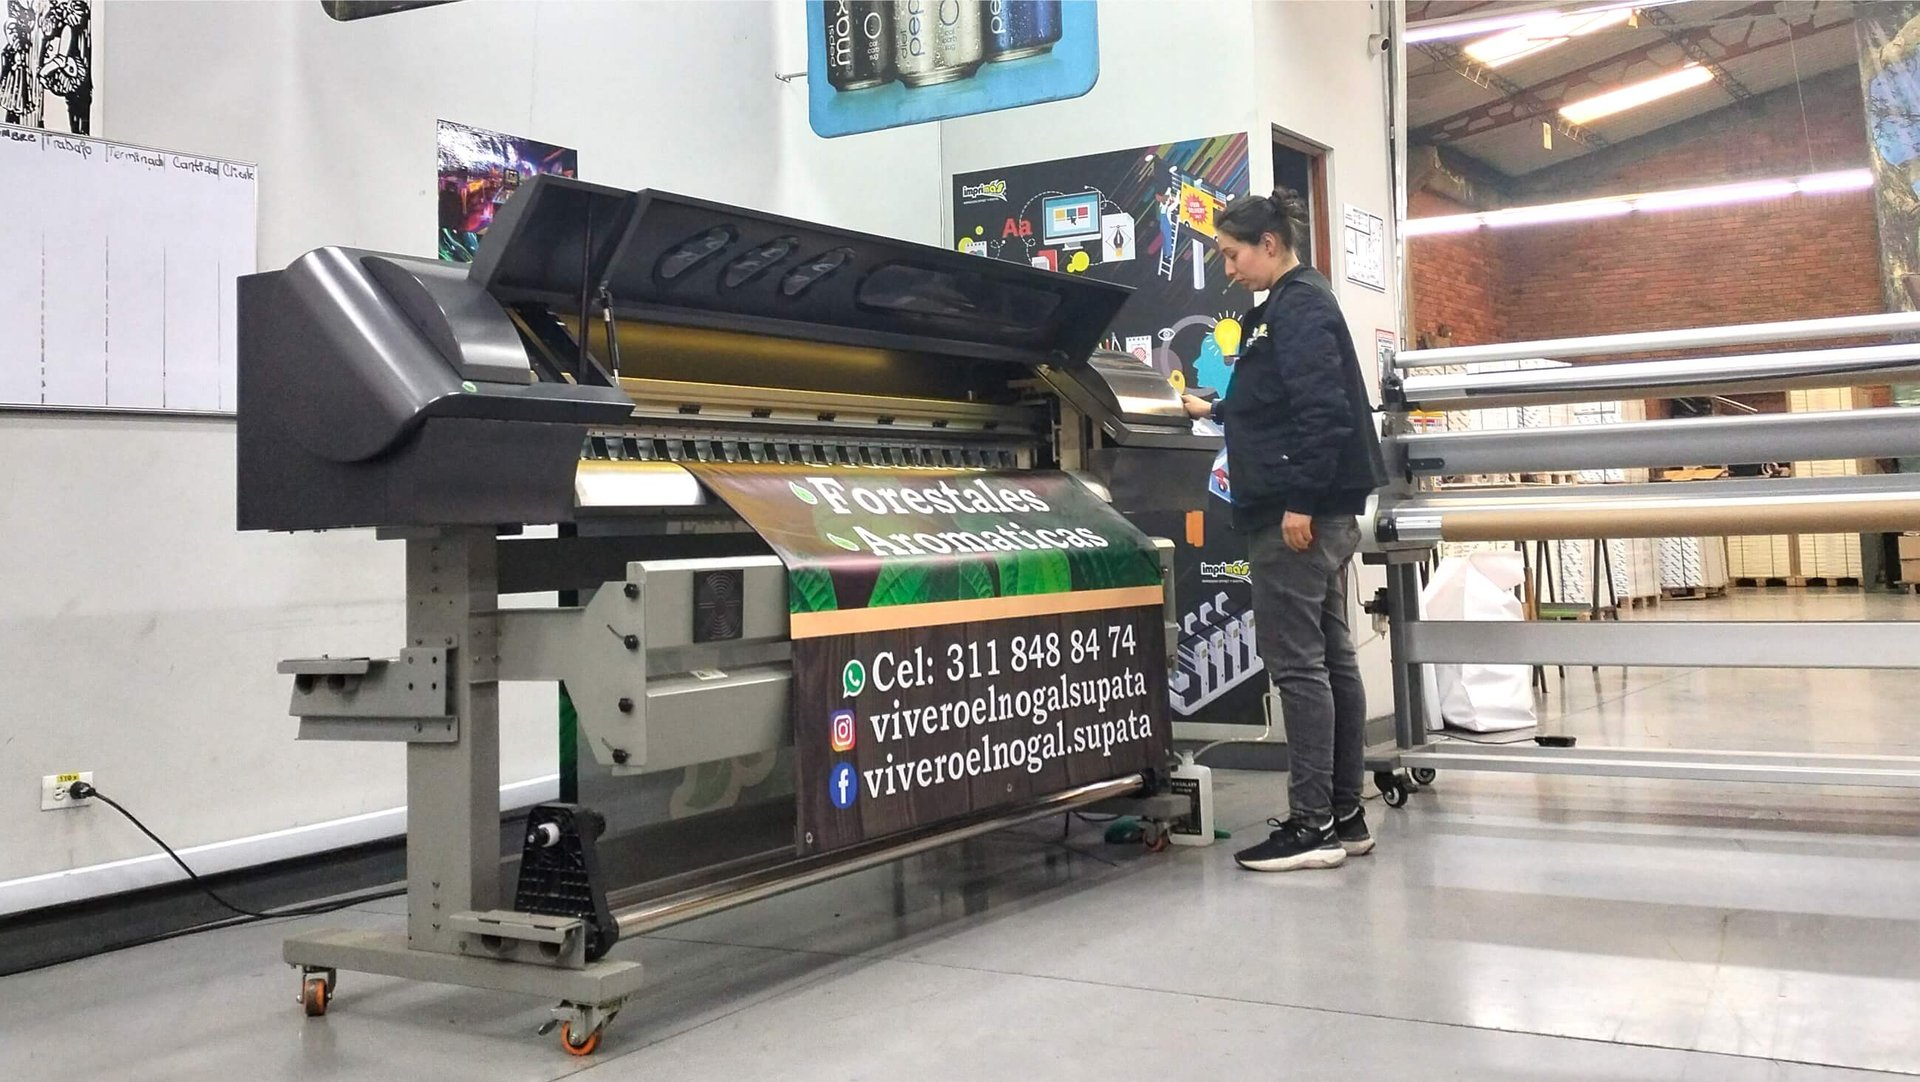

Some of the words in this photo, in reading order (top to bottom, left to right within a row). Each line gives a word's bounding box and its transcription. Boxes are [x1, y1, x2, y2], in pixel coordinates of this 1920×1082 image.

[1002, 217, 1034, 239] Aa
[805, 477, 1051, 515] Forestales
[852, 521, 1109, 557] Aromaticas
[871, 646, 935, 693] Cel:
[946, 639, 1001, 682] 311
[1010, 632, 1061, 673] 848
[1070, 628, 1101, 665] 84
[1107, 624, 1137, 659] 74
[869, 666, 1147, 743] viveroelnogalsupata
[863, 712, 1153, 799] viveroelnogal.supata
